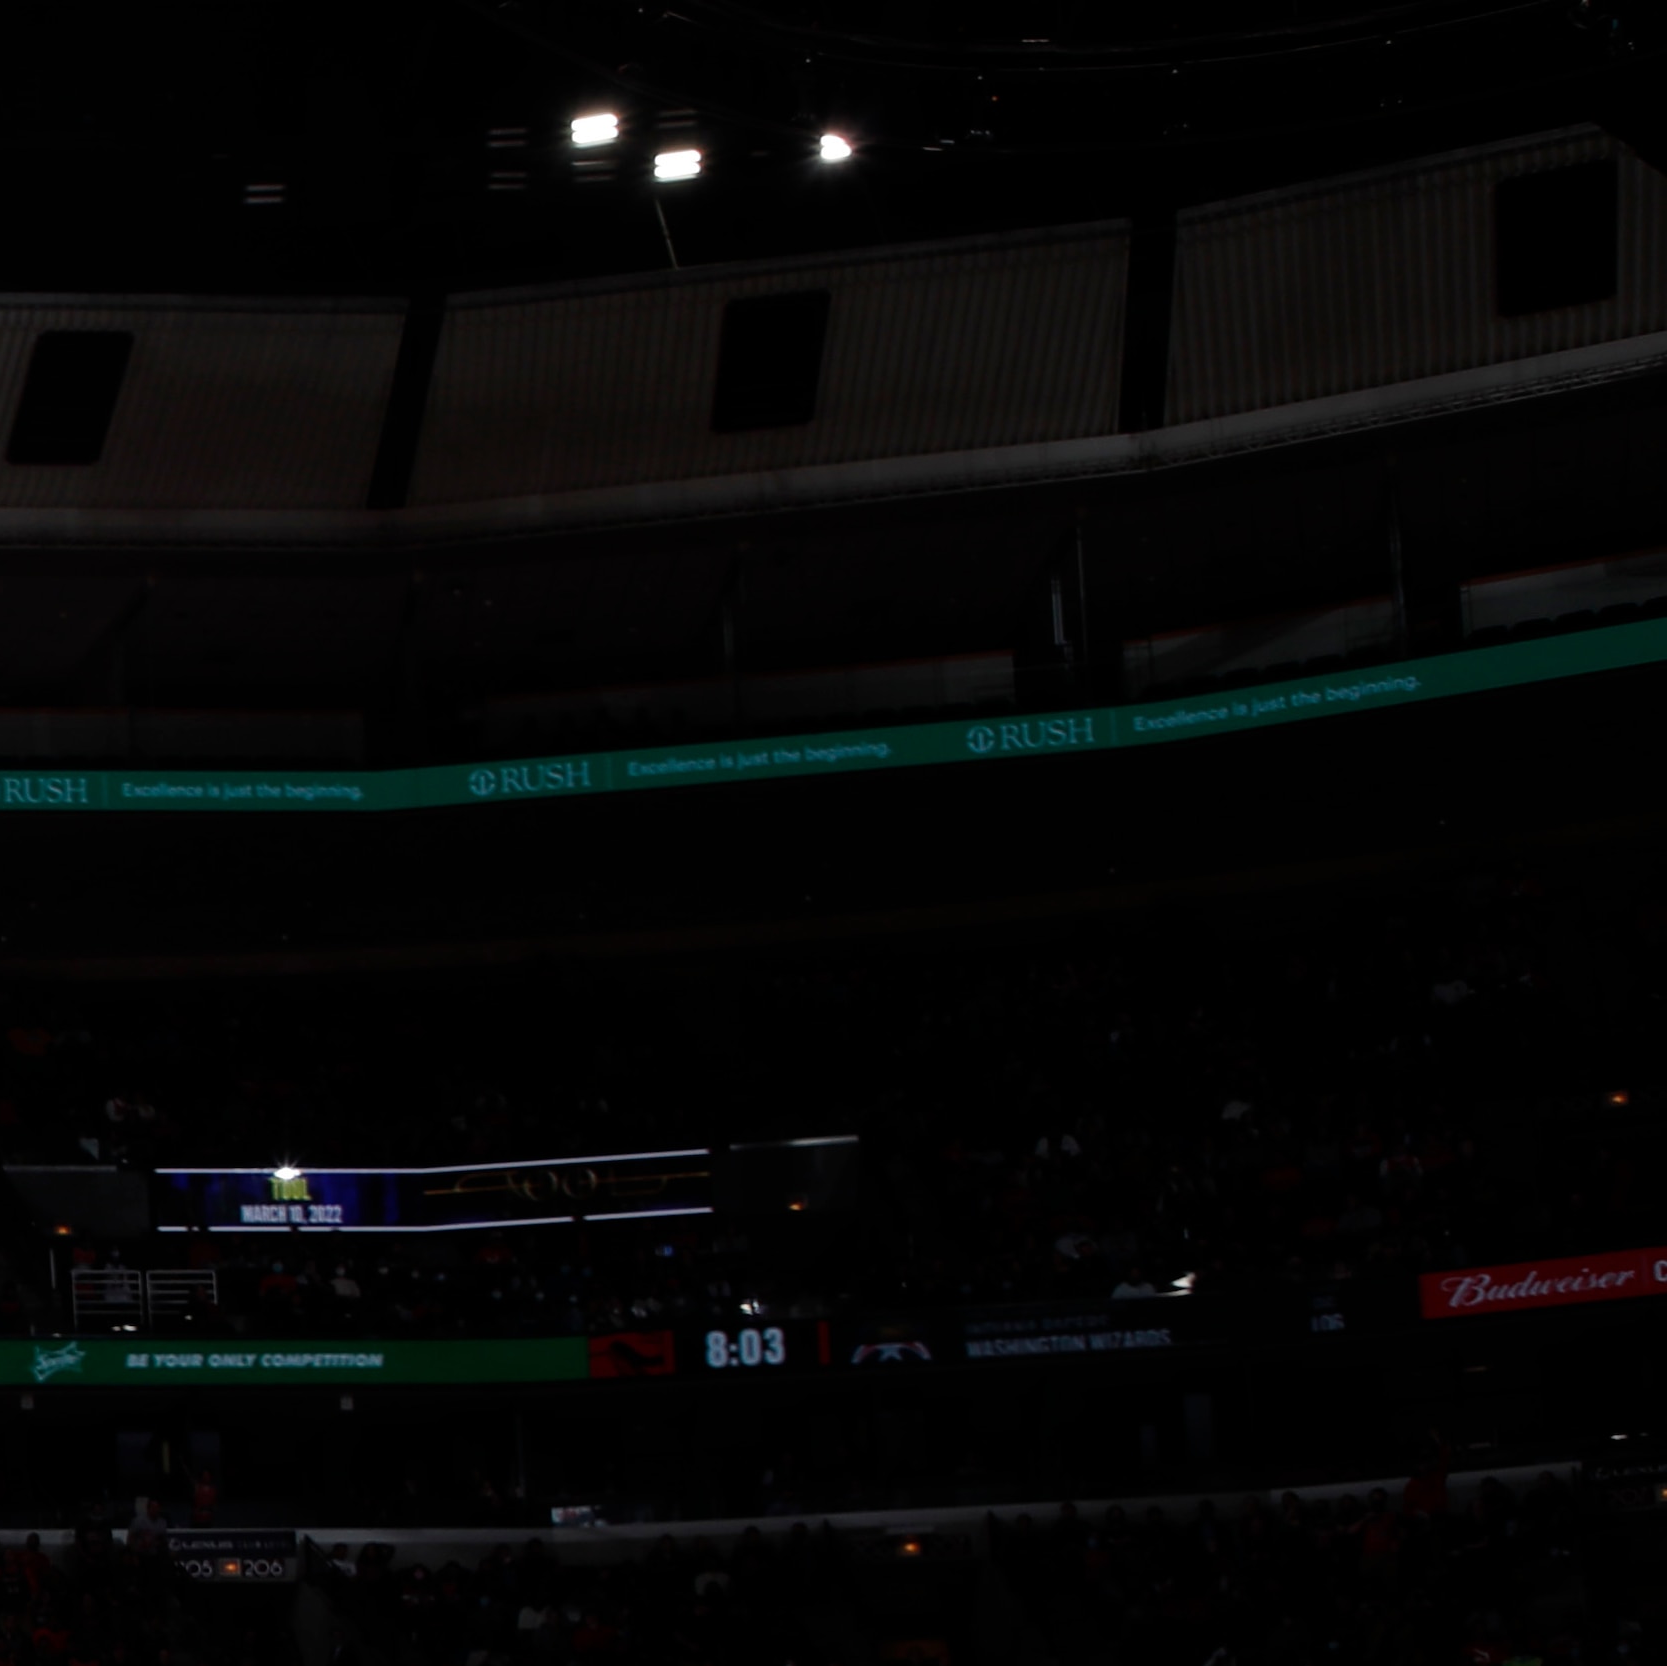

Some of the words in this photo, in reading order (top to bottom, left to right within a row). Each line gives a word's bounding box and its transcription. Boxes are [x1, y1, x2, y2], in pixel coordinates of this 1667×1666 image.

[1133, 706, 1229, 731] Excellence
[1232, 700, 1247, 718] is
[1249, 697, 1288, 721] just
[1290, 690, 1323, 709] the
[1325, 673, 1422, 702] beginning.
[1000, 717, 1096, 753] RUSH
[3, 778, 88, 804] RUSH
[501, 762, 591, 794] RUSH
[241, 1204, 286, 1224] MARCH
[288, 1204, 307, 1225] 10,
[307, 1204, 344, 1224] 2022
[1438, 1266, 1636, 1308] Budweiser
[125, 1353, 150, 1369] BE
[151, 1353, 205, 1369] YOUR
[207, 1353, 257, 1369] ONLY
[260, 1353, 385, 1369] COMPETITION
[703, 1328, 787, 1370] 8:03
